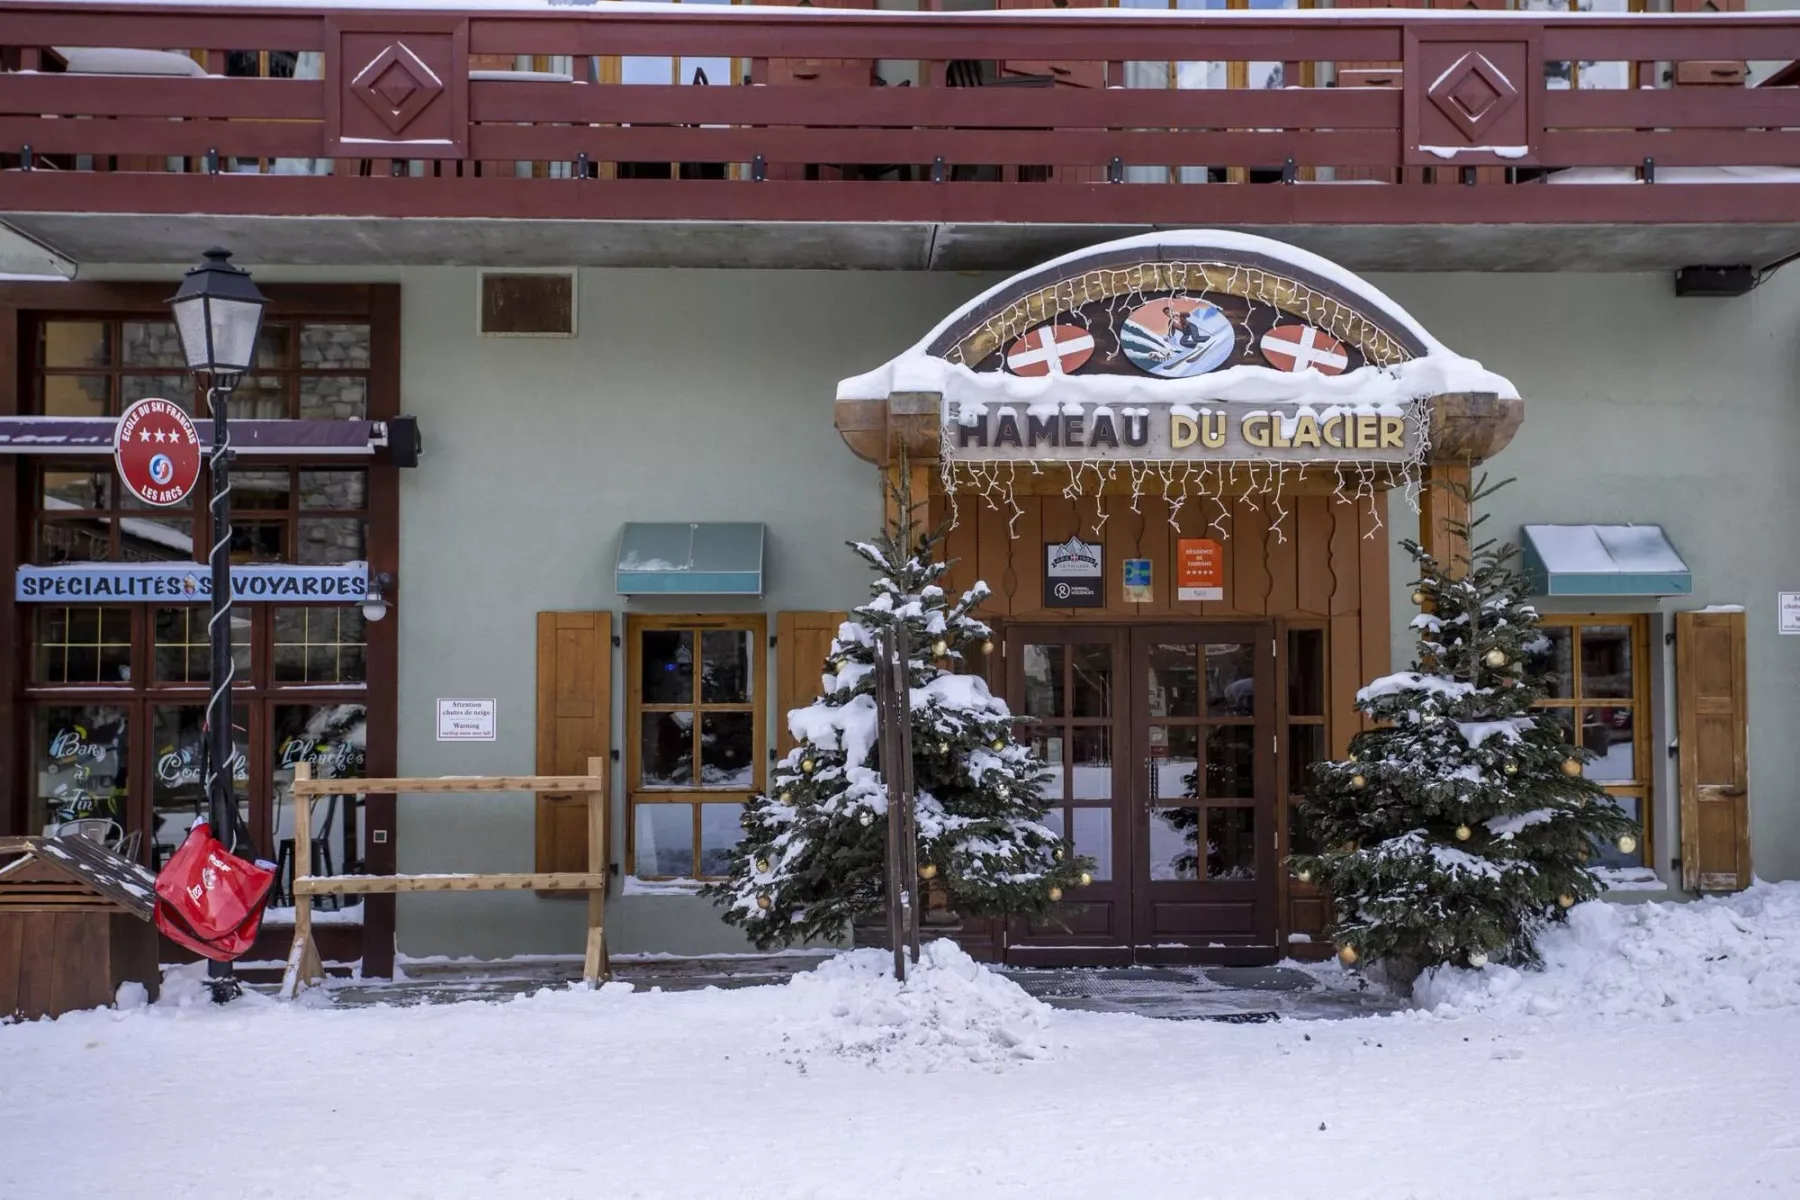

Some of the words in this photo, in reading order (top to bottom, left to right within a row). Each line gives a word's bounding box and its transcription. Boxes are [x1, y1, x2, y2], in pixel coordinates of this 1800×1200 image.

[121, 411, 140, 442] ECOLE
[138, 403, 150, 417] DU
[151, 401, 165, 413] SKI
[959, 410, 1149, 448] HAMEAU
[1169, 411, 1227, 448] DU
[1241, 411, 1405, 448] GLACIER
[141, 484, 158, 501] LES
[159, 485, 183, 502] ARCS
[22, 574, 182, 597] SPÉCIALITÉS
[200, 574, 366, 597] SVOYARDES
[473, 709, 491, 717] neige
